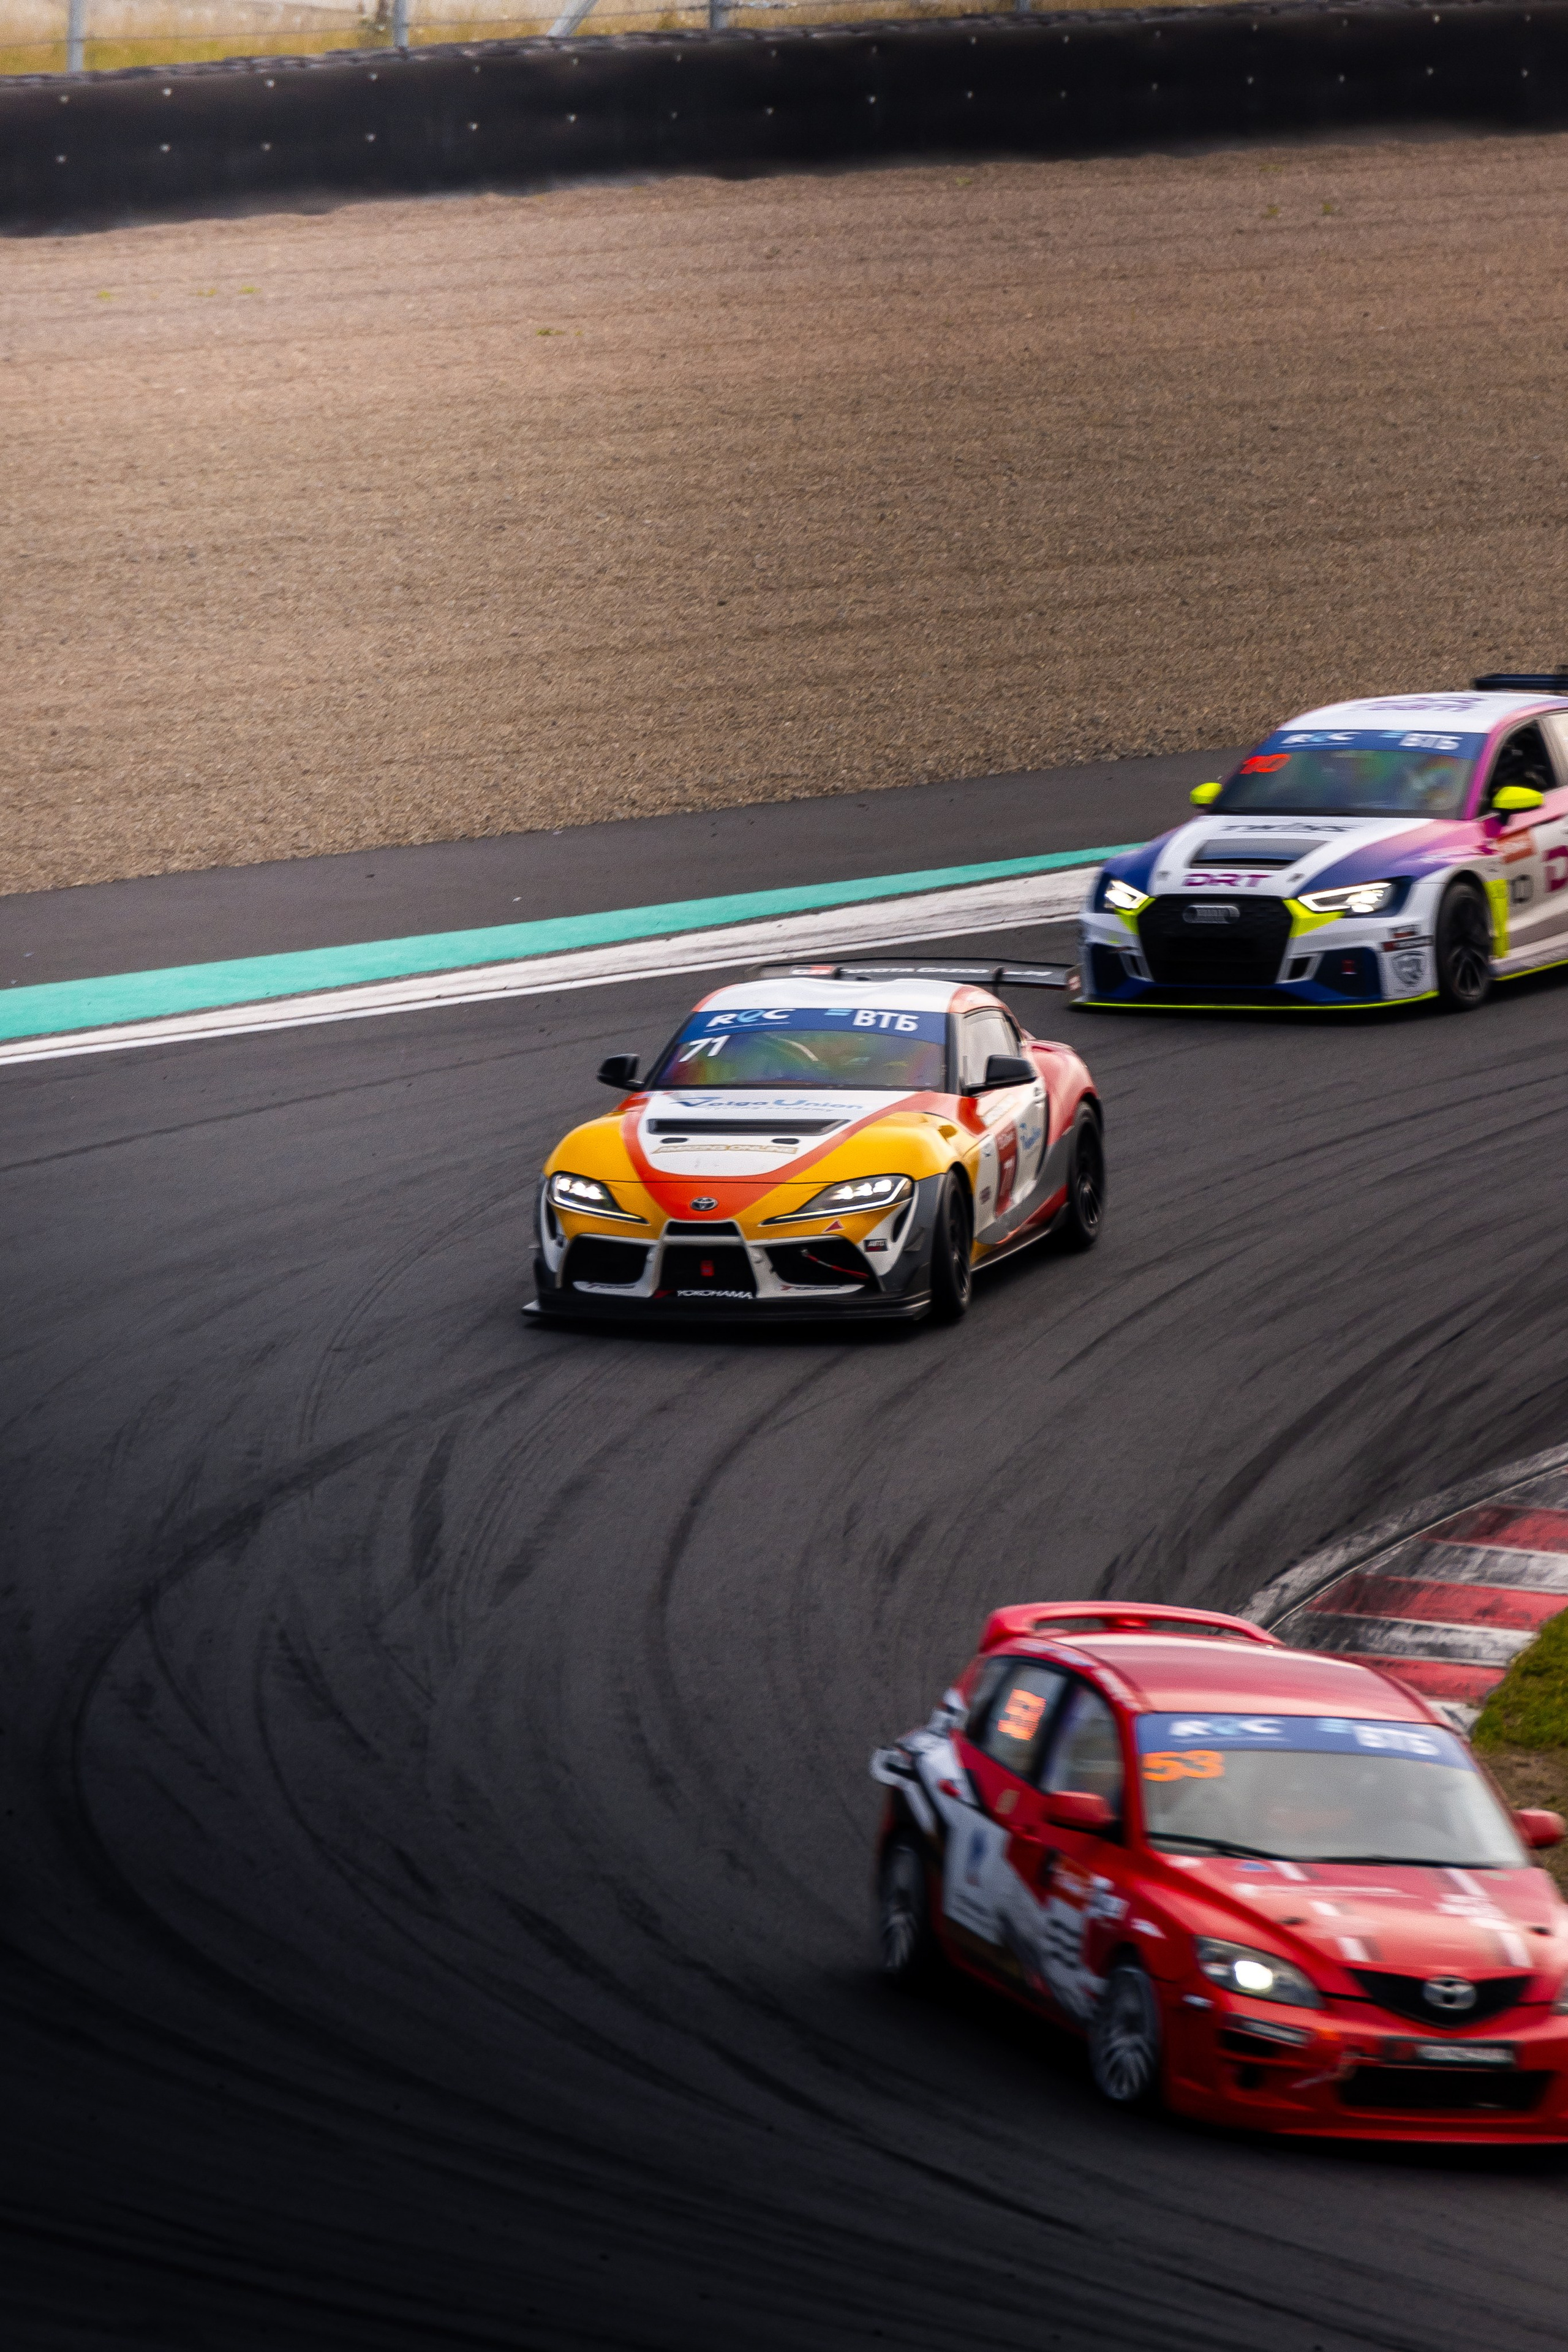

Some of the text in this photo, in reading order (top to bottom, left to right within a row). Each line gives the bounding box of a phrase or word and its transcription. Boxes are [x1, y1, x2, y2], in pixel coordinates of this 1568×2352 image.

[852, 1010, 920, 1031] ВТБ
[678, 1035, 731, 1063] 71
[677, 1290, 754, 1299] YOKOHAMA
[1142, 1749, 1224, 1782] 53
